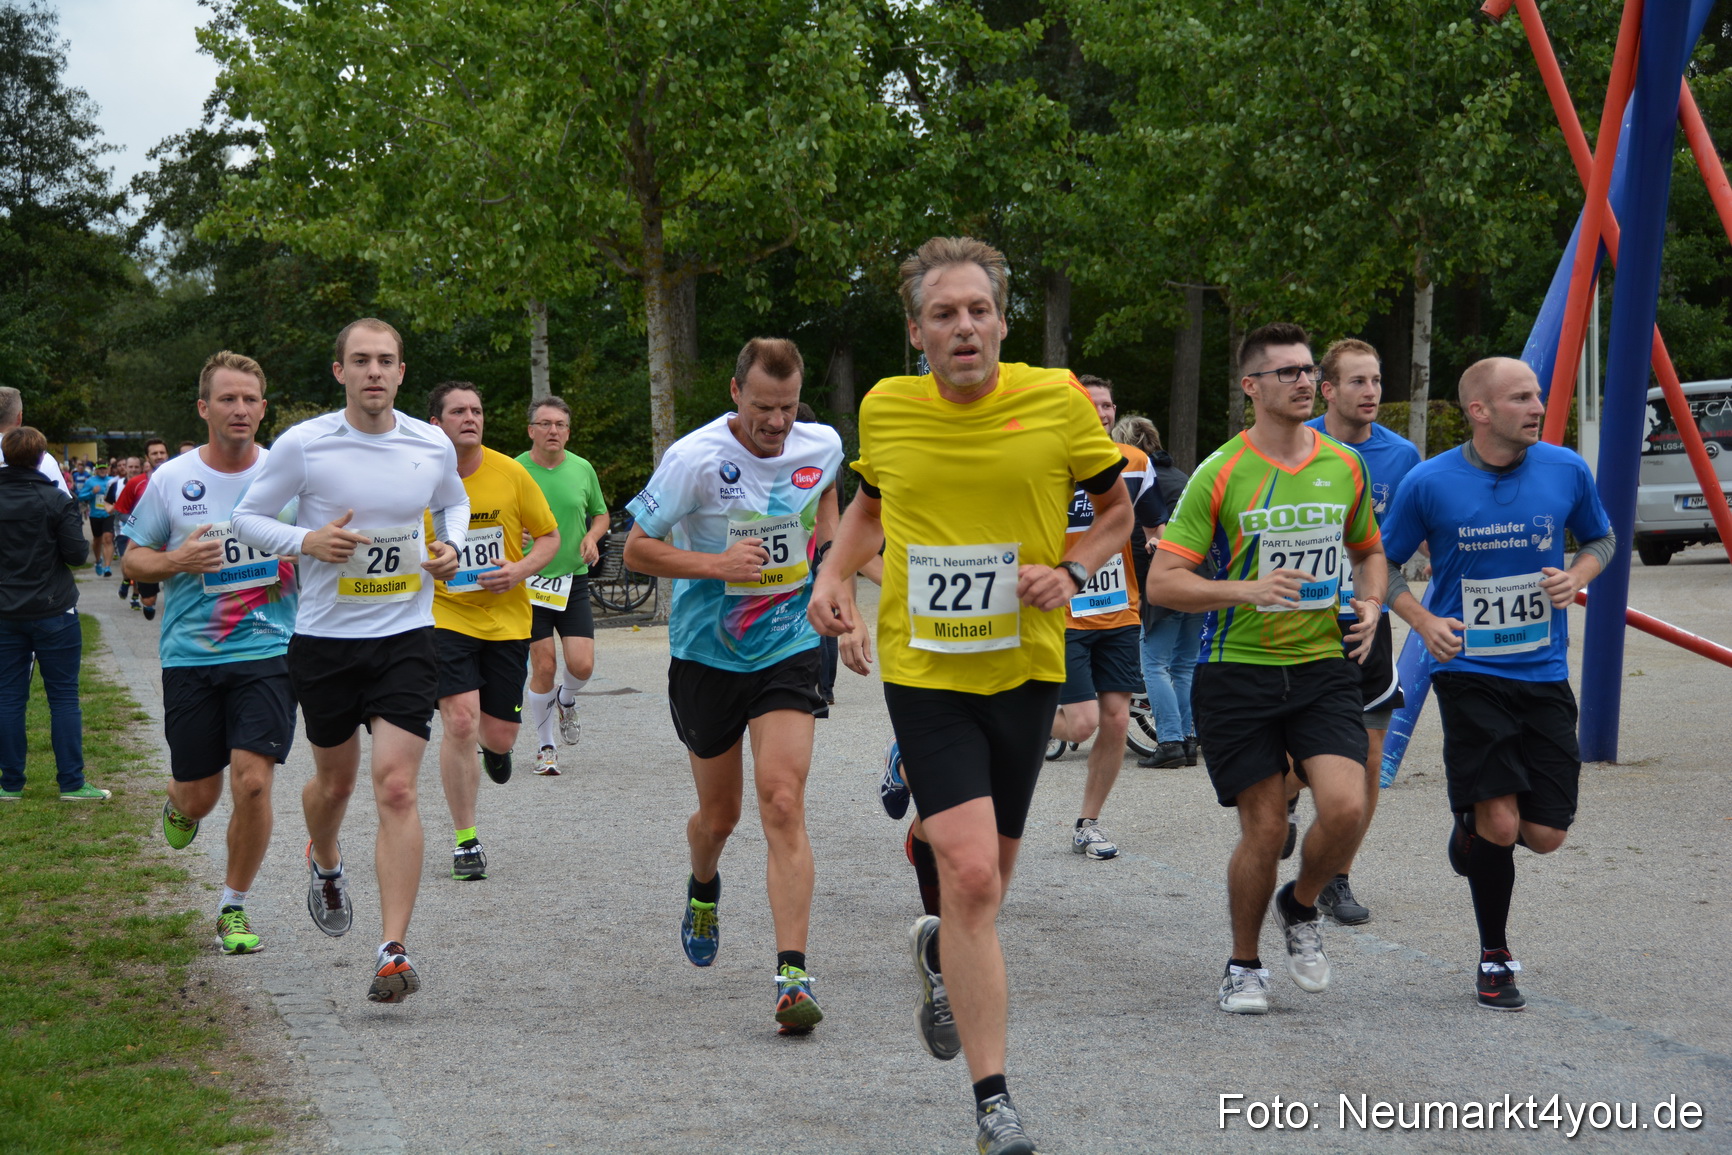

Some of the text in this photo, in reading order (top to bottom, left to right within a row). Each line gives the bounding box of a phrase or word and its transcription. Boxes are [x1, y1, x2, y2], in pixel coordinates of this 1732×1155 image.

[795, 471, 821, 483] Hervis
[719, 487, 745, 495] PARTL
[182, 504, 208, 512] PARTL
[1074, 500, 1093, 511] Fis
[1239, 503, 1347, 536] BOCK
[203, 529, 225, 538] ARTL
[729, 520, 799, 537] PARTL Neumarkt
[1458, 522, 1525, 537] Kirwaläufer
[373, 533, 411, 543] Neumarkt
[1262, 535, 1333, 548] PARTL Neumarkt
[1458, 537, 1528, 551] Pettenhofen
[366, 546, 400, 574] 26
[457, 541, 500, 568] 180
[910, 555, 998, 567] PARTL Neumarkt
[1269, 546, 1337, 577] 2770
[220, 567, 267, 582] Christian
[467, 573, 479, 583] Uw
[759, 573, 784, 585] Uwe
[354, 580, 407, 593] Sebastian
[1076, 568, 1119, 595] 401
[1464, 581, 1536, 594] PARTL Neumarkt
[535, 592, 551, 602] Gerd
[928, 571, 996, 611] 227
[1089, 596, 1112, 607] David
[1473, 591, 1544, 625] 2145
[934, 621, 992, 638] Michael
[1494, 629, 1527, 644] Benni
